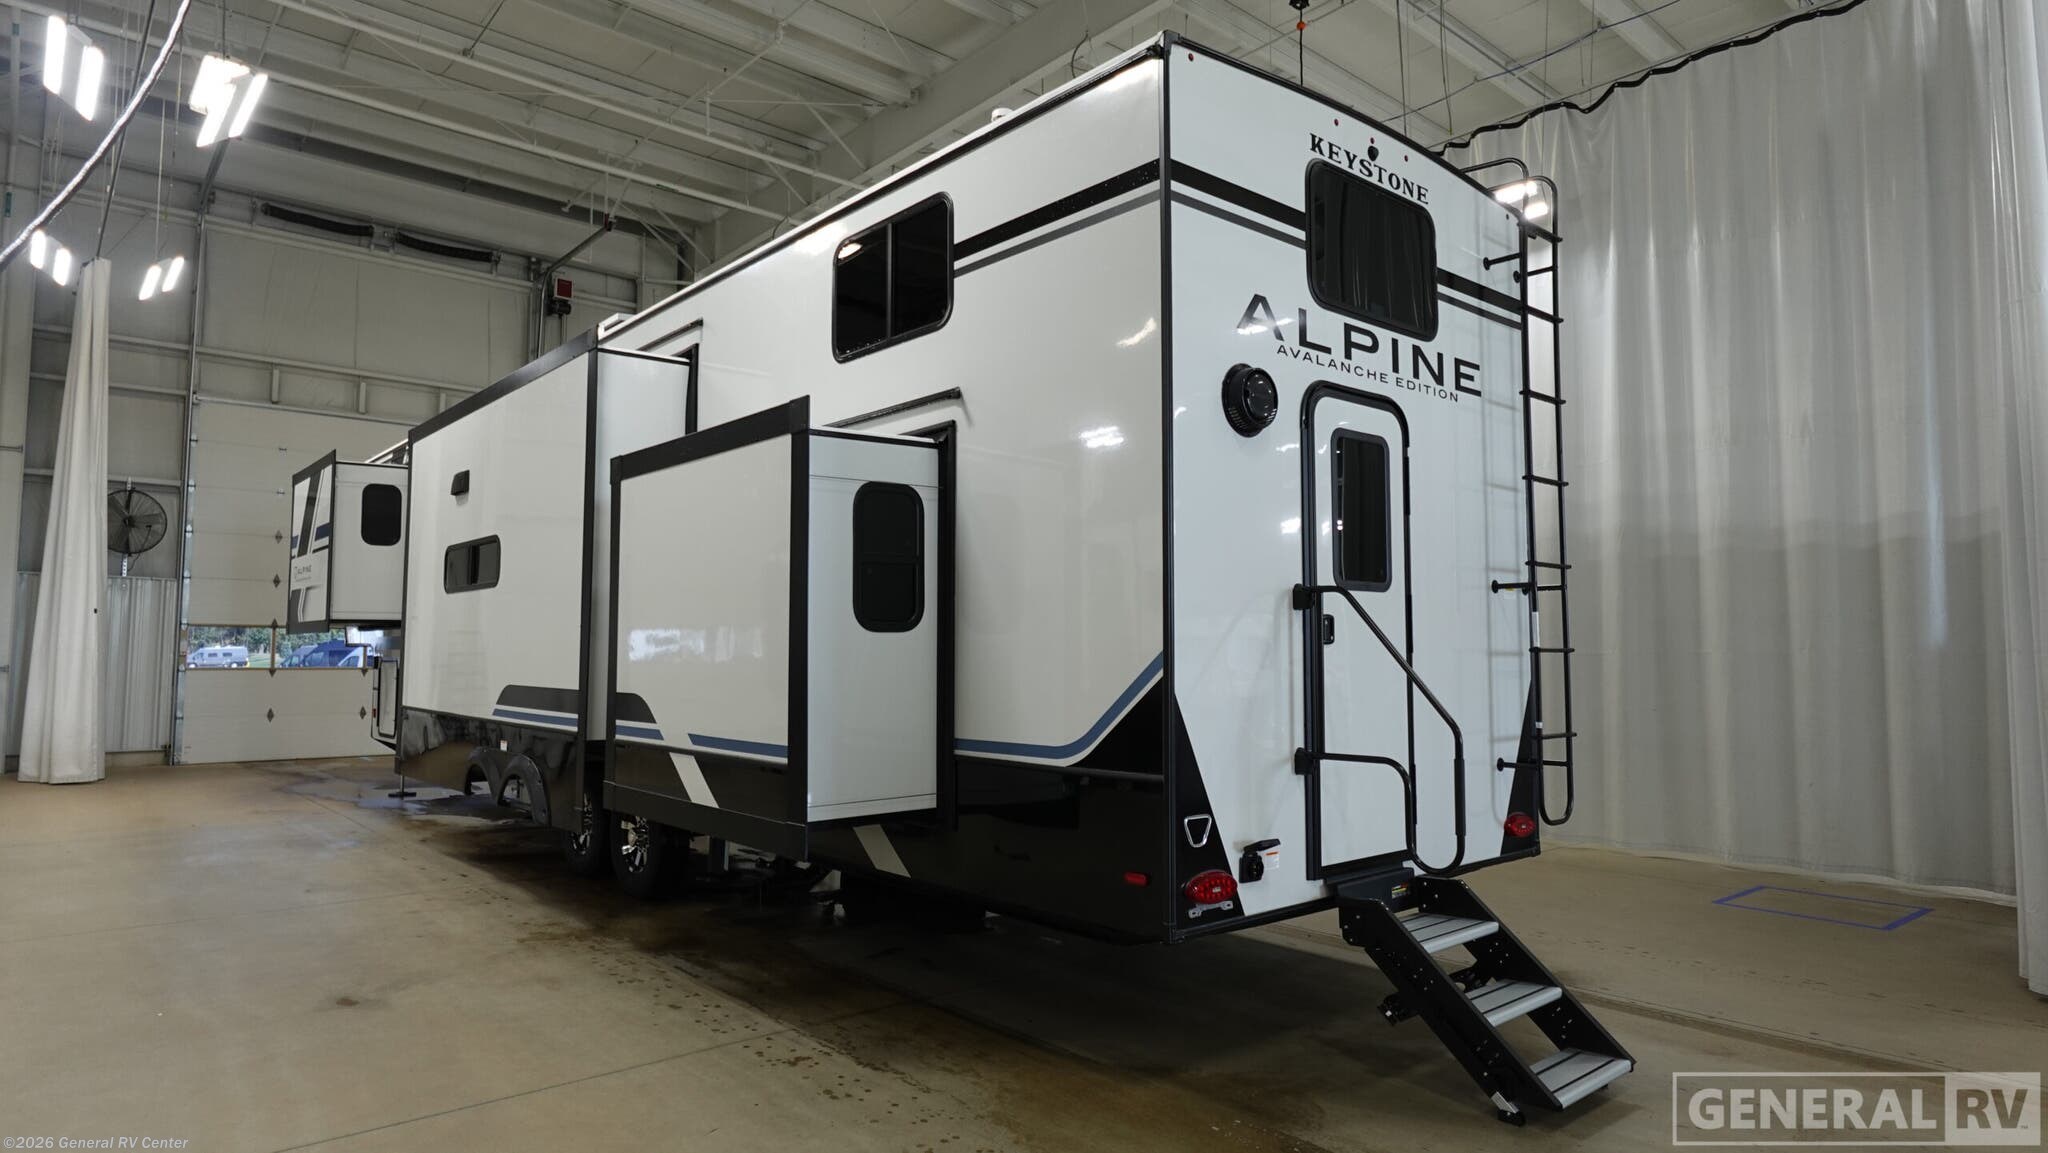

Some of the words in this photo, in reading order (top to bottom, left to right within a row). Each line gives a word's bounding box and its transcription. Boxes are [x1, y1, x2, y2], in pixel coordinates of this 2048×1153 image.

[1309, 133, 1429, 205] KEYSTONE
[1237, 293, 1482, 397] ALPINE
[1276, 344, 1389, 384] AVALANCHE
[1395, 377, 1459, 403] EDITION
